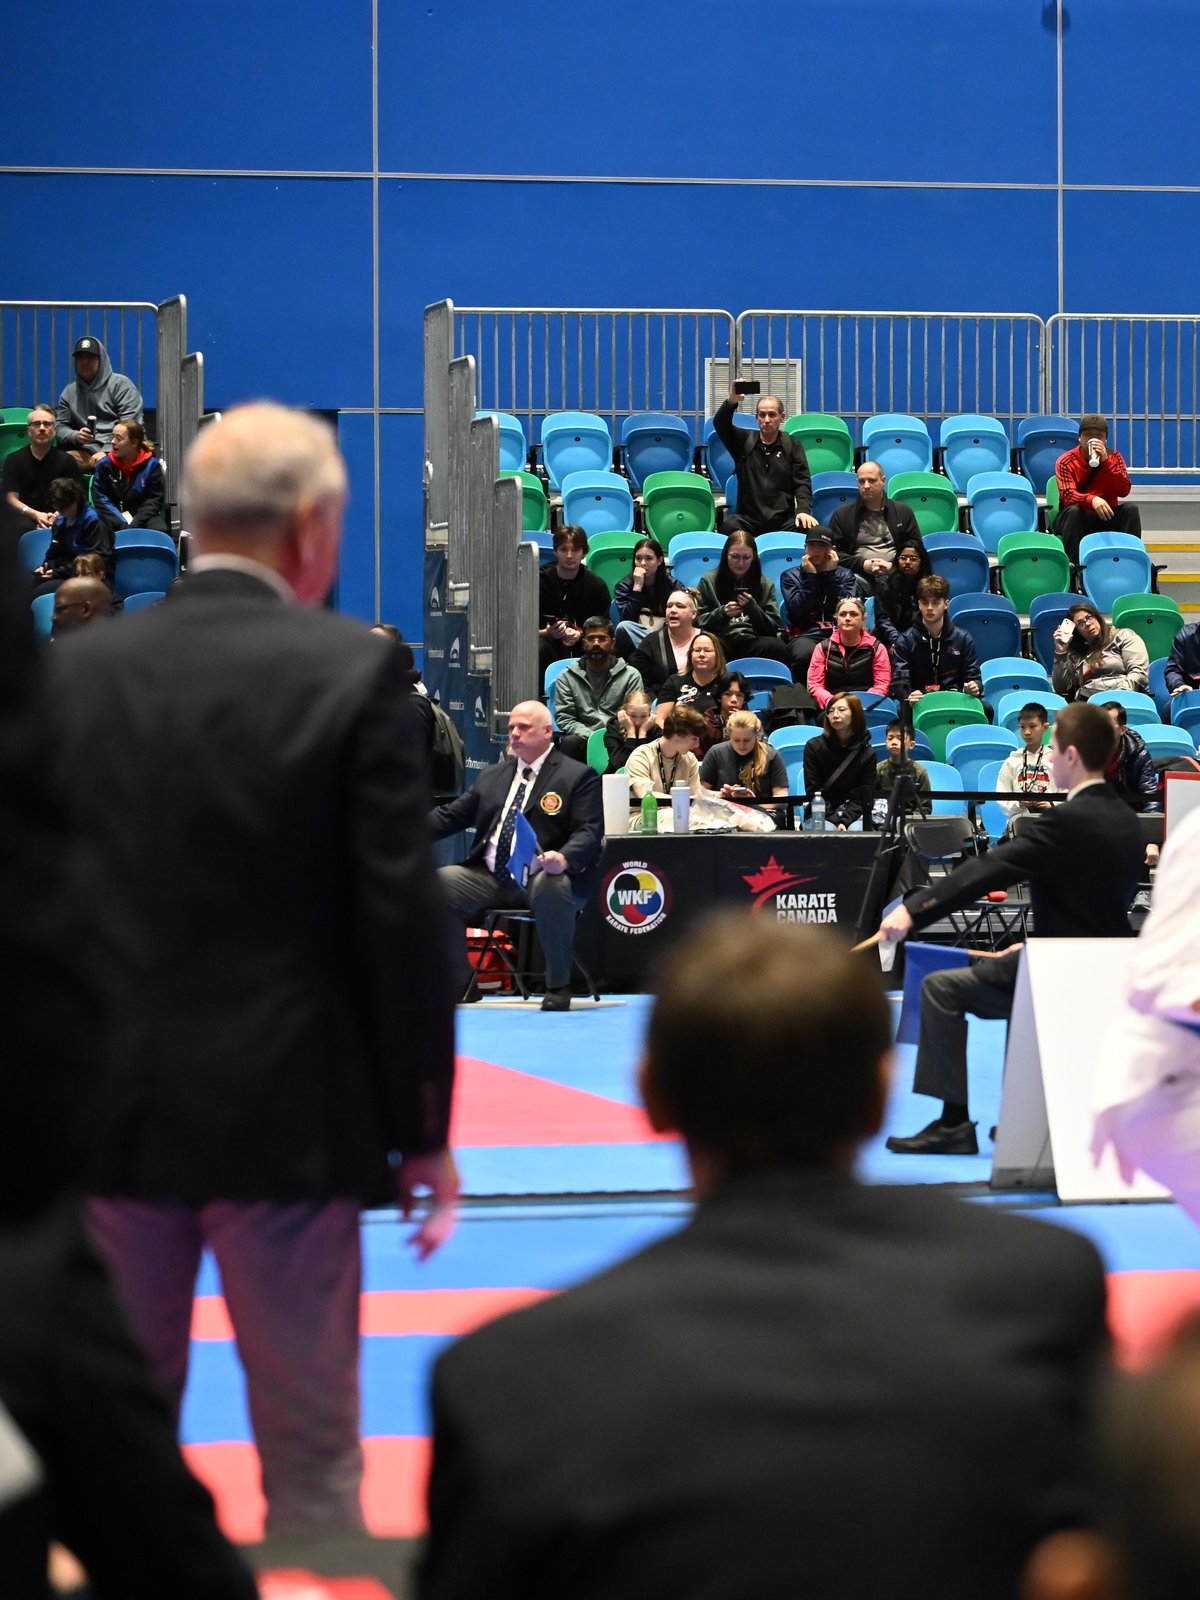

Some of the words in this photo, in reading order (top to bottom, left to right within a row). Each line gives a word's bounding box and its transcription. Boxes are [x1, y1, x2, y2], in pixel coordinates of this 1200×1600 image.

[622, 861, 648, 869] WORLD
[617, 890, 652, 905] WKF
[776, 893, 837, 909] KARATE
[605, 914, 629, 934] KARATE
[629, 912, 667, 935] FEDERATION
[776, 909, 838, 924] CANADA
